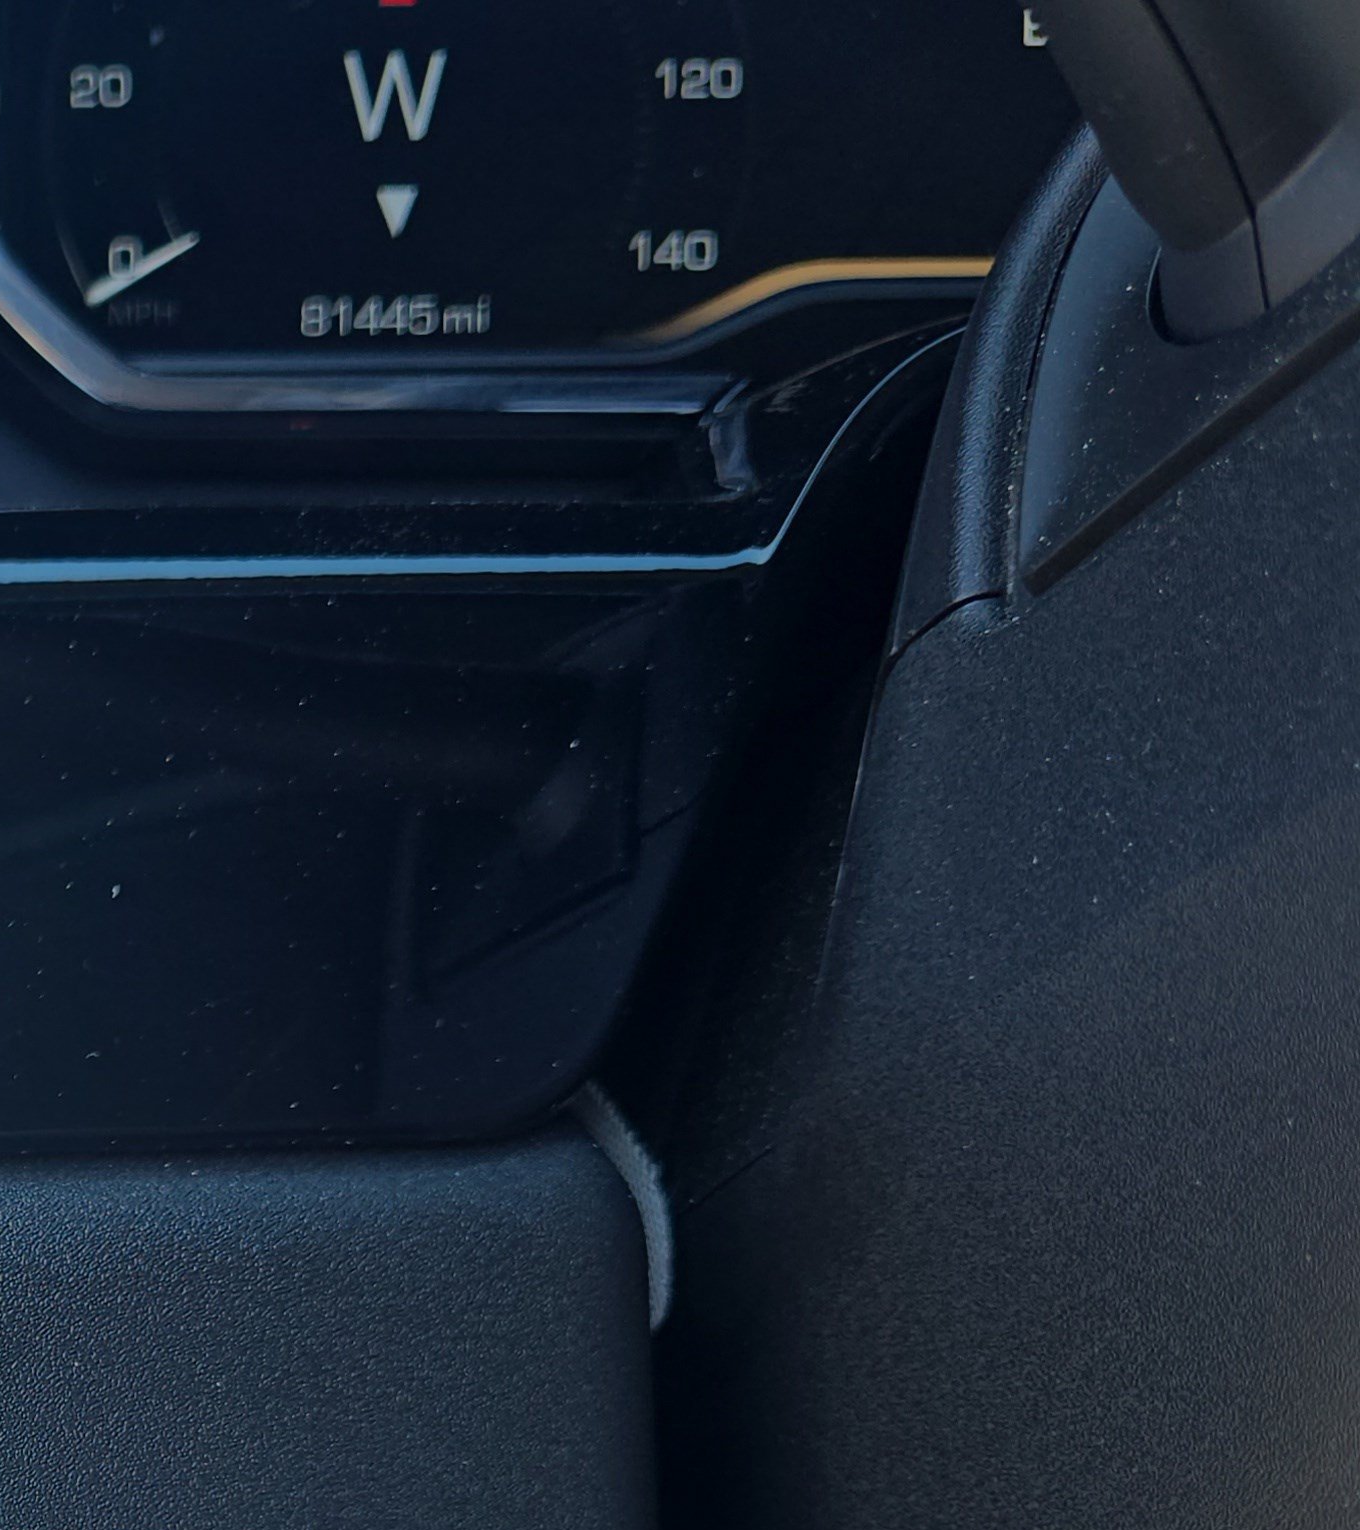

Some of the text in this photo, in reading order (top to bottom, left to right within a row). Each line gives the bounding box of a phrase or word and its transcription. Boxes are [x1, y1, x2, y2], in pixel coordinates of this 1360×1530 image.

[70, 64, 132, 108] 20
[343, 48, 448, 142] W
[655, 57, 743, 99] 120
[108, 235, 143, 280] 0
[628, 229, 718, 272] 140
